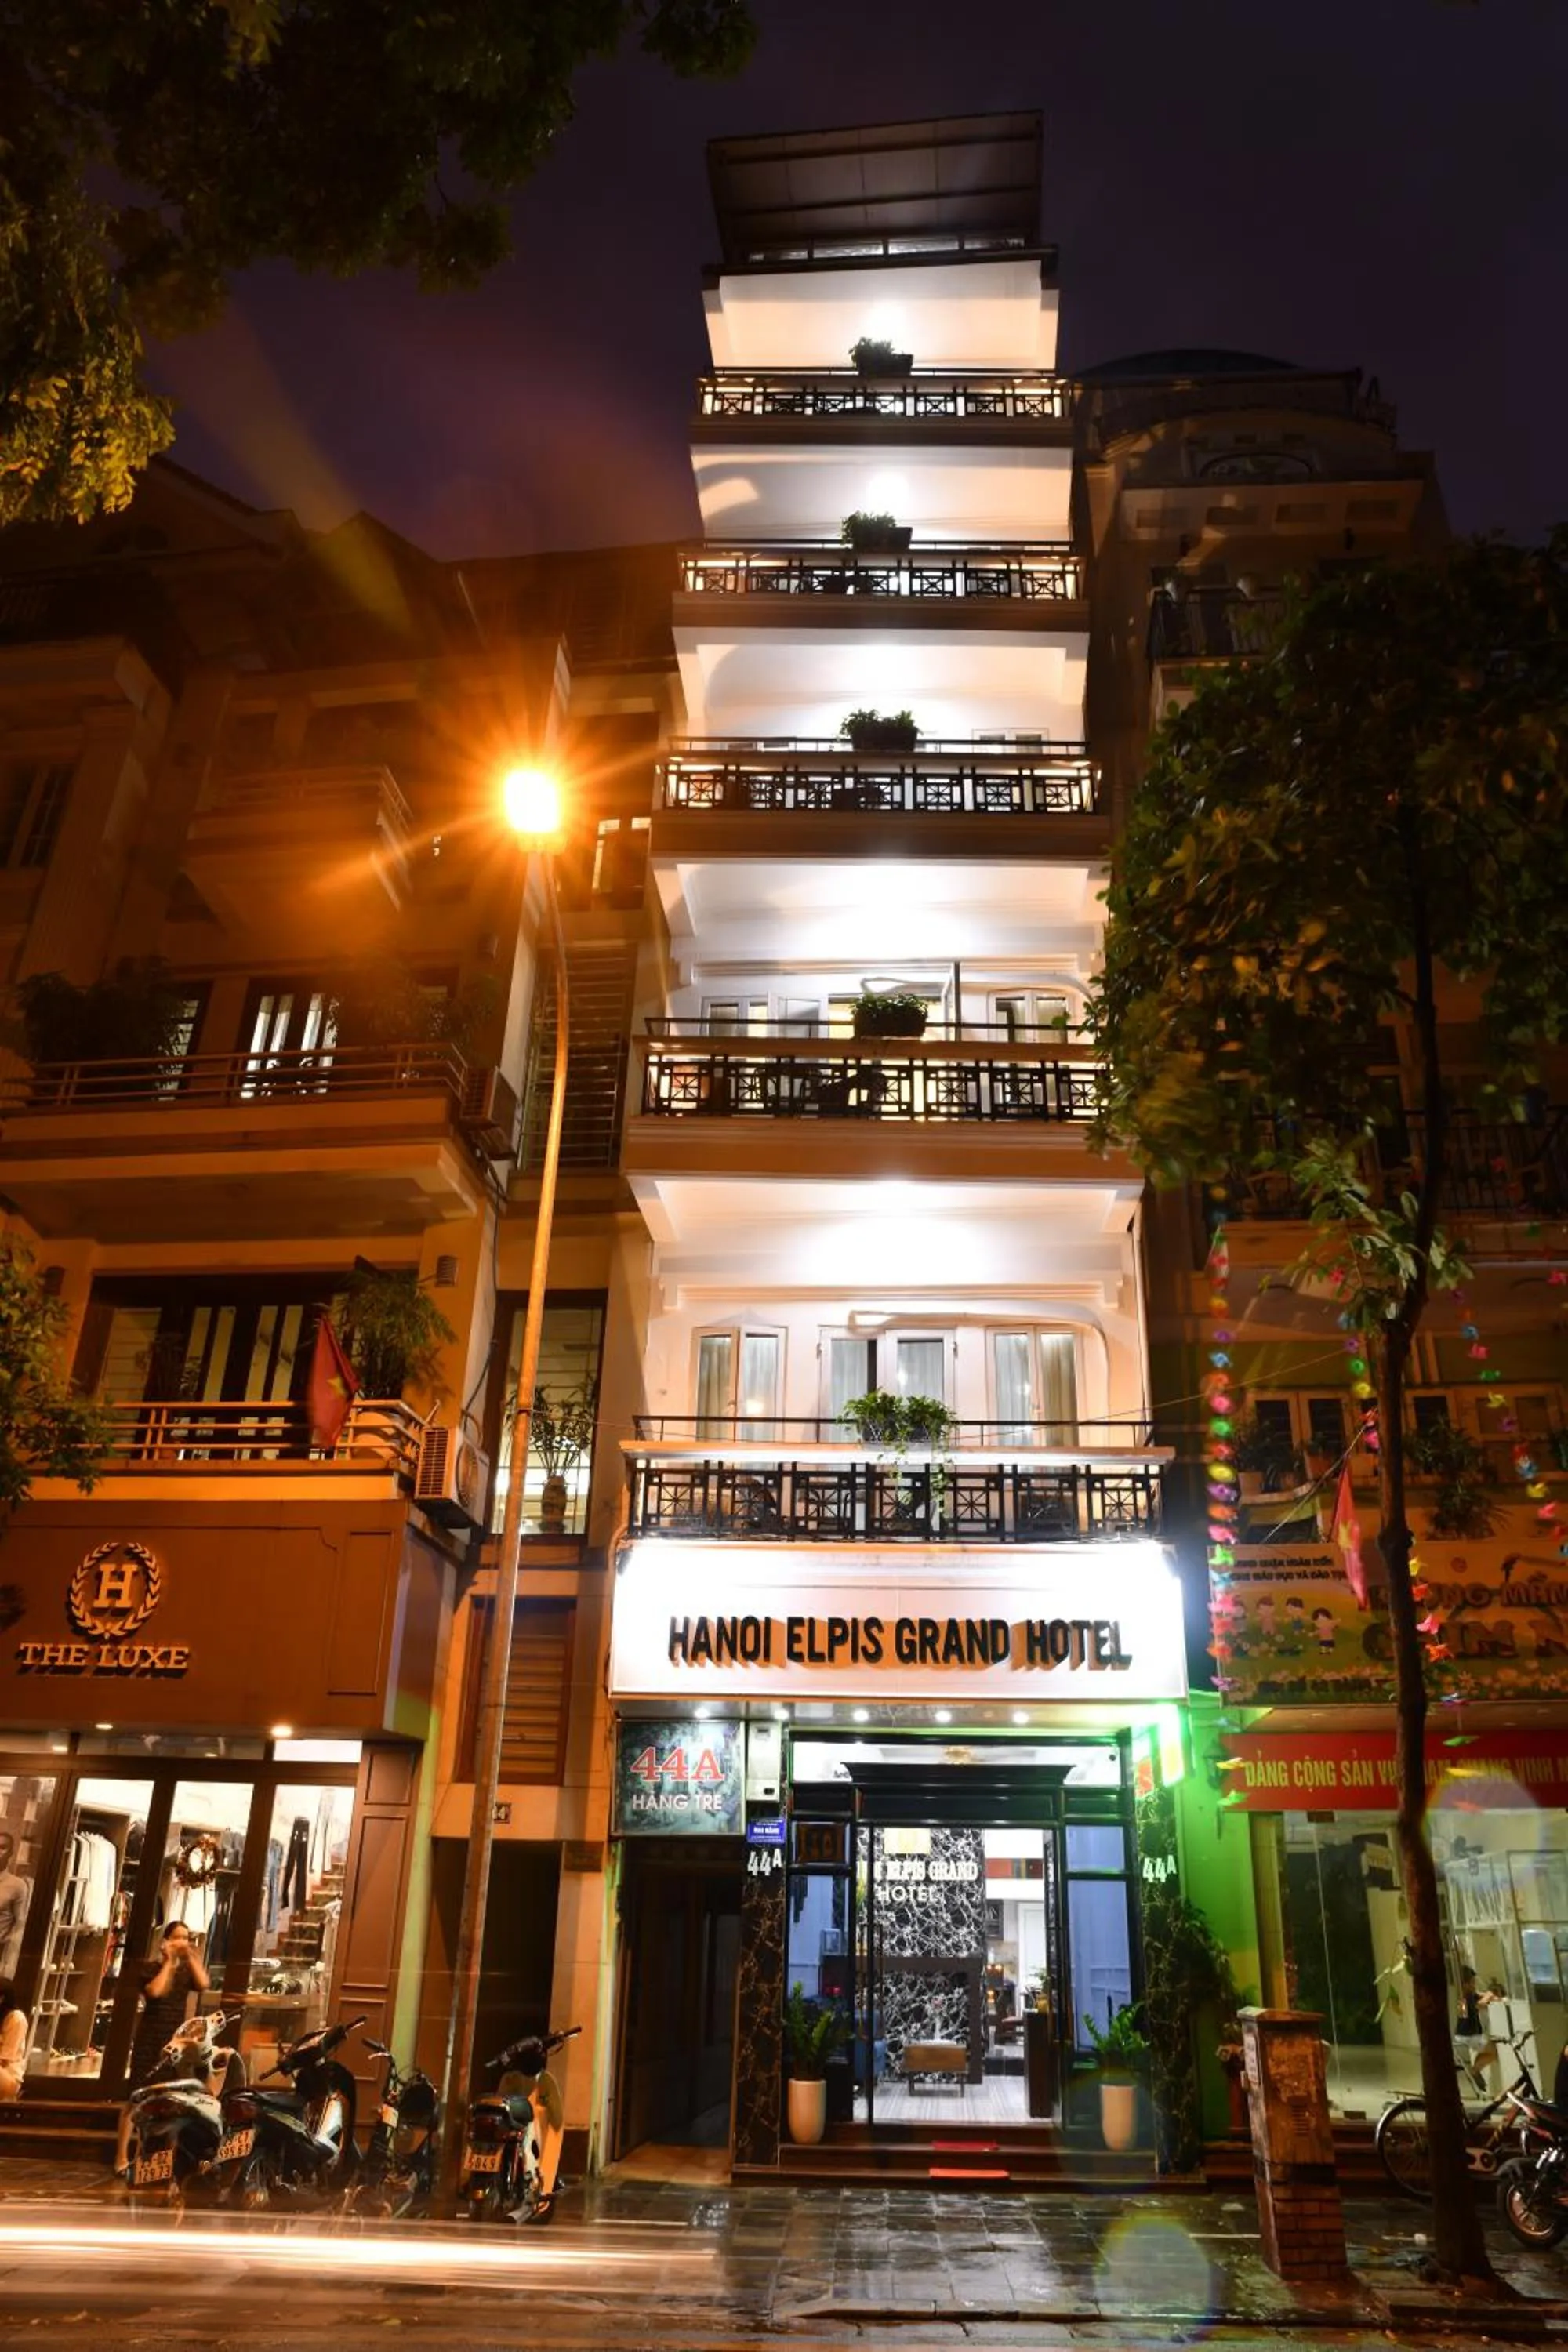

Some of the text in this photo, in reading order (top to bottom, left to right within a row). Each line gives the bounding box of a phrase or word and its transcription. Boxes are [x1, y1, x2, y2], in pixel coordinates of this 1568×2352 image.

[93, 1564, 138, 1607] H
[20, 1643, 189, 1670] THE LUXE
[668, 1616, 1133, 1669] HANOI ELPIS GRAND HOTEL
[630, 1746, 726, 1782] 44A
[1245, 1749, 1290, 1788] ĐẢNG
[1294, 1755, 1338, 1794] CỘNG
[1341, 1748, 1375, 1788] SẢN
[695, 1792, 723, 1811] TRE
[747, 1848, 783, 1877] 44A
[1142, 1854, 1177, 1882] 44A
[876, 1884, 938, 1903] HOTEL
